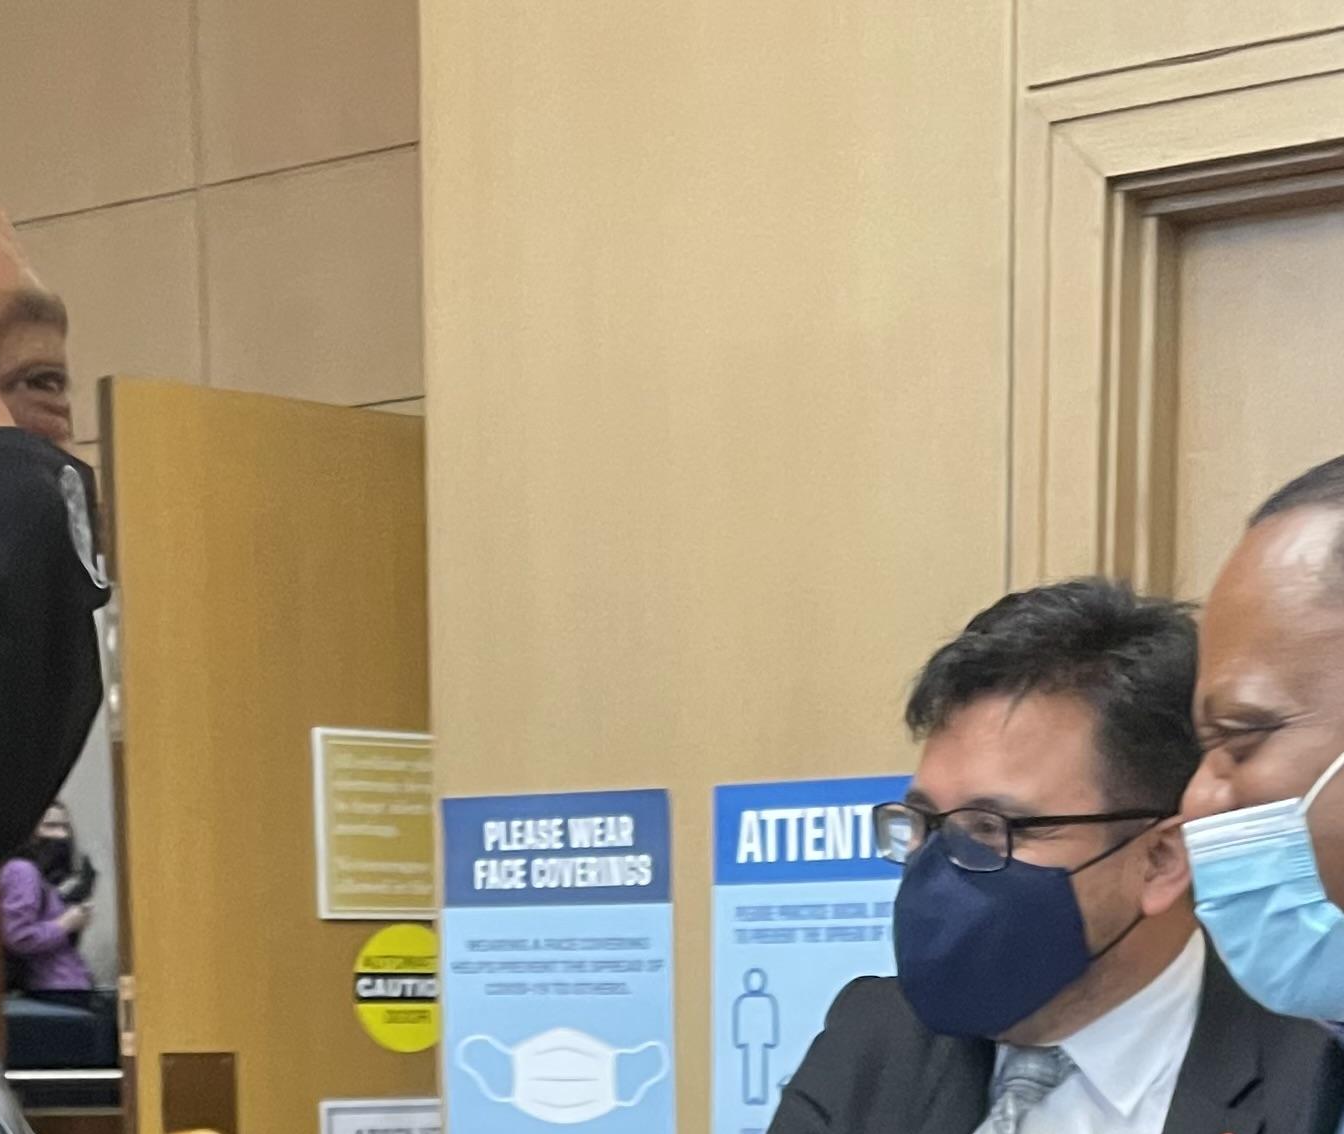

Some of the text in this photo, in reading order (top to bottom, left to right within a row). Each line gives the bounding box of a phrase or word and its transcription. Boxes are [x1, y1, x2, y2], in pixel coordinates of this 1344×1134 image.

[483, 815, 634, 851] PLEASE WEAR
[736, 803, 885, 864] ATTENT
[473, 854, 653, 890] FACE COVERINGS
